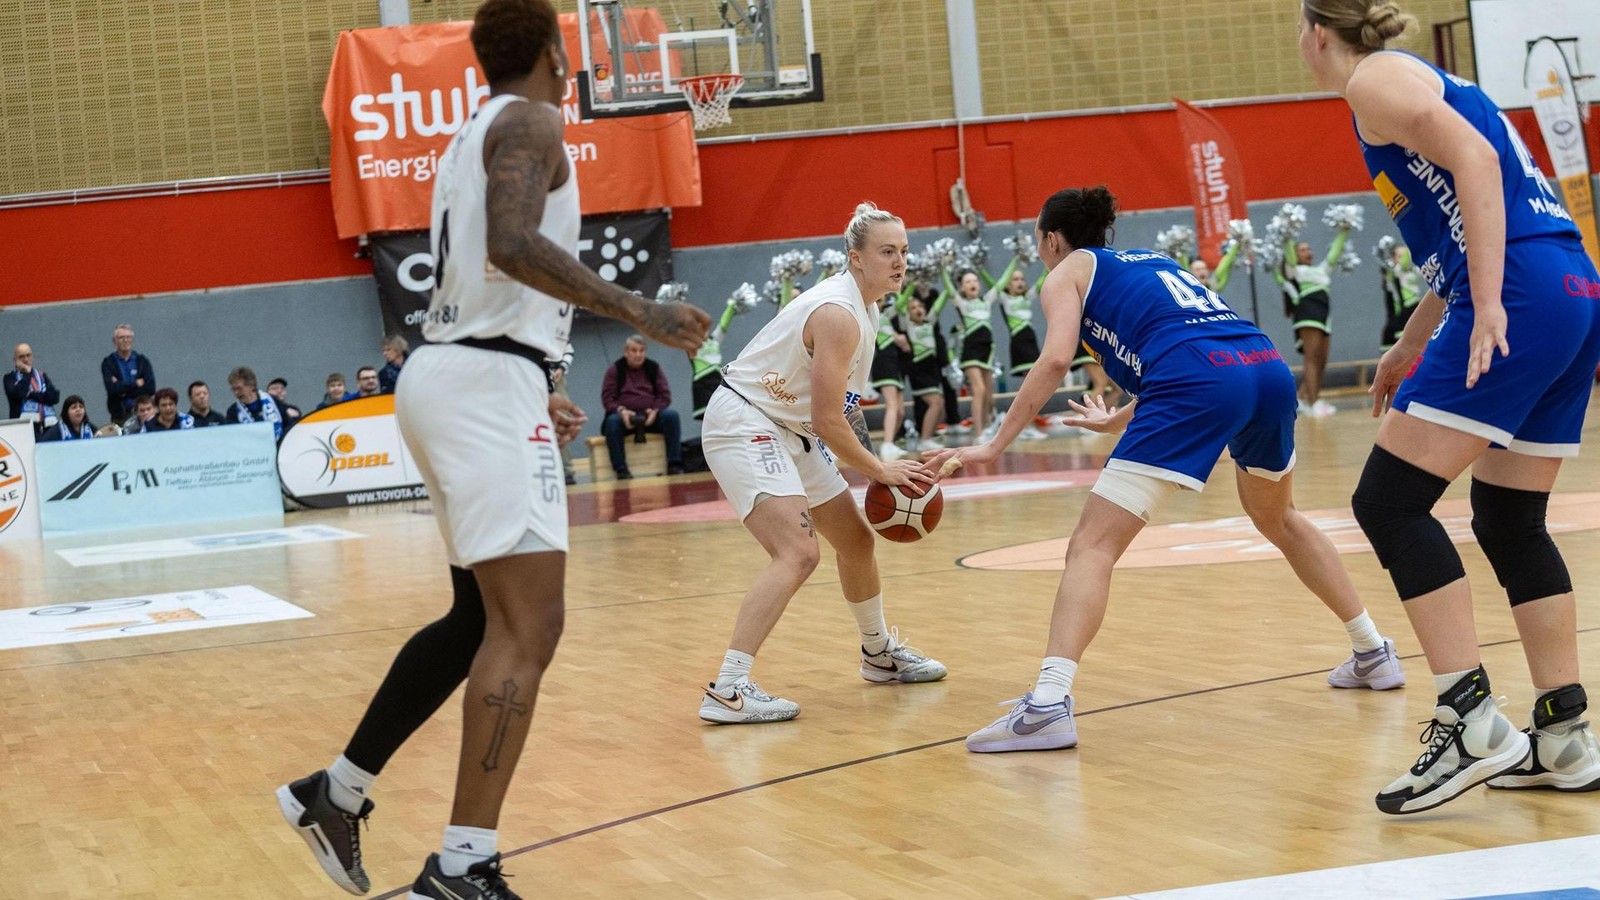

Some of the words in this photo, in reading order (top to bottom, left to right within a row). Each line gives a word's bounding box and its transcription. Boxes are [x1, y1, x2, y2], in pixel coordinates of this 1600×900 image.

[357, 149, 437, 182] Energi
[1202, 140, 1230, 203] stwh
[1155, 269, 1231, 313] 42
[329, 452, 395, 471] DBBL
[527, 424, 562, 504] stwh
